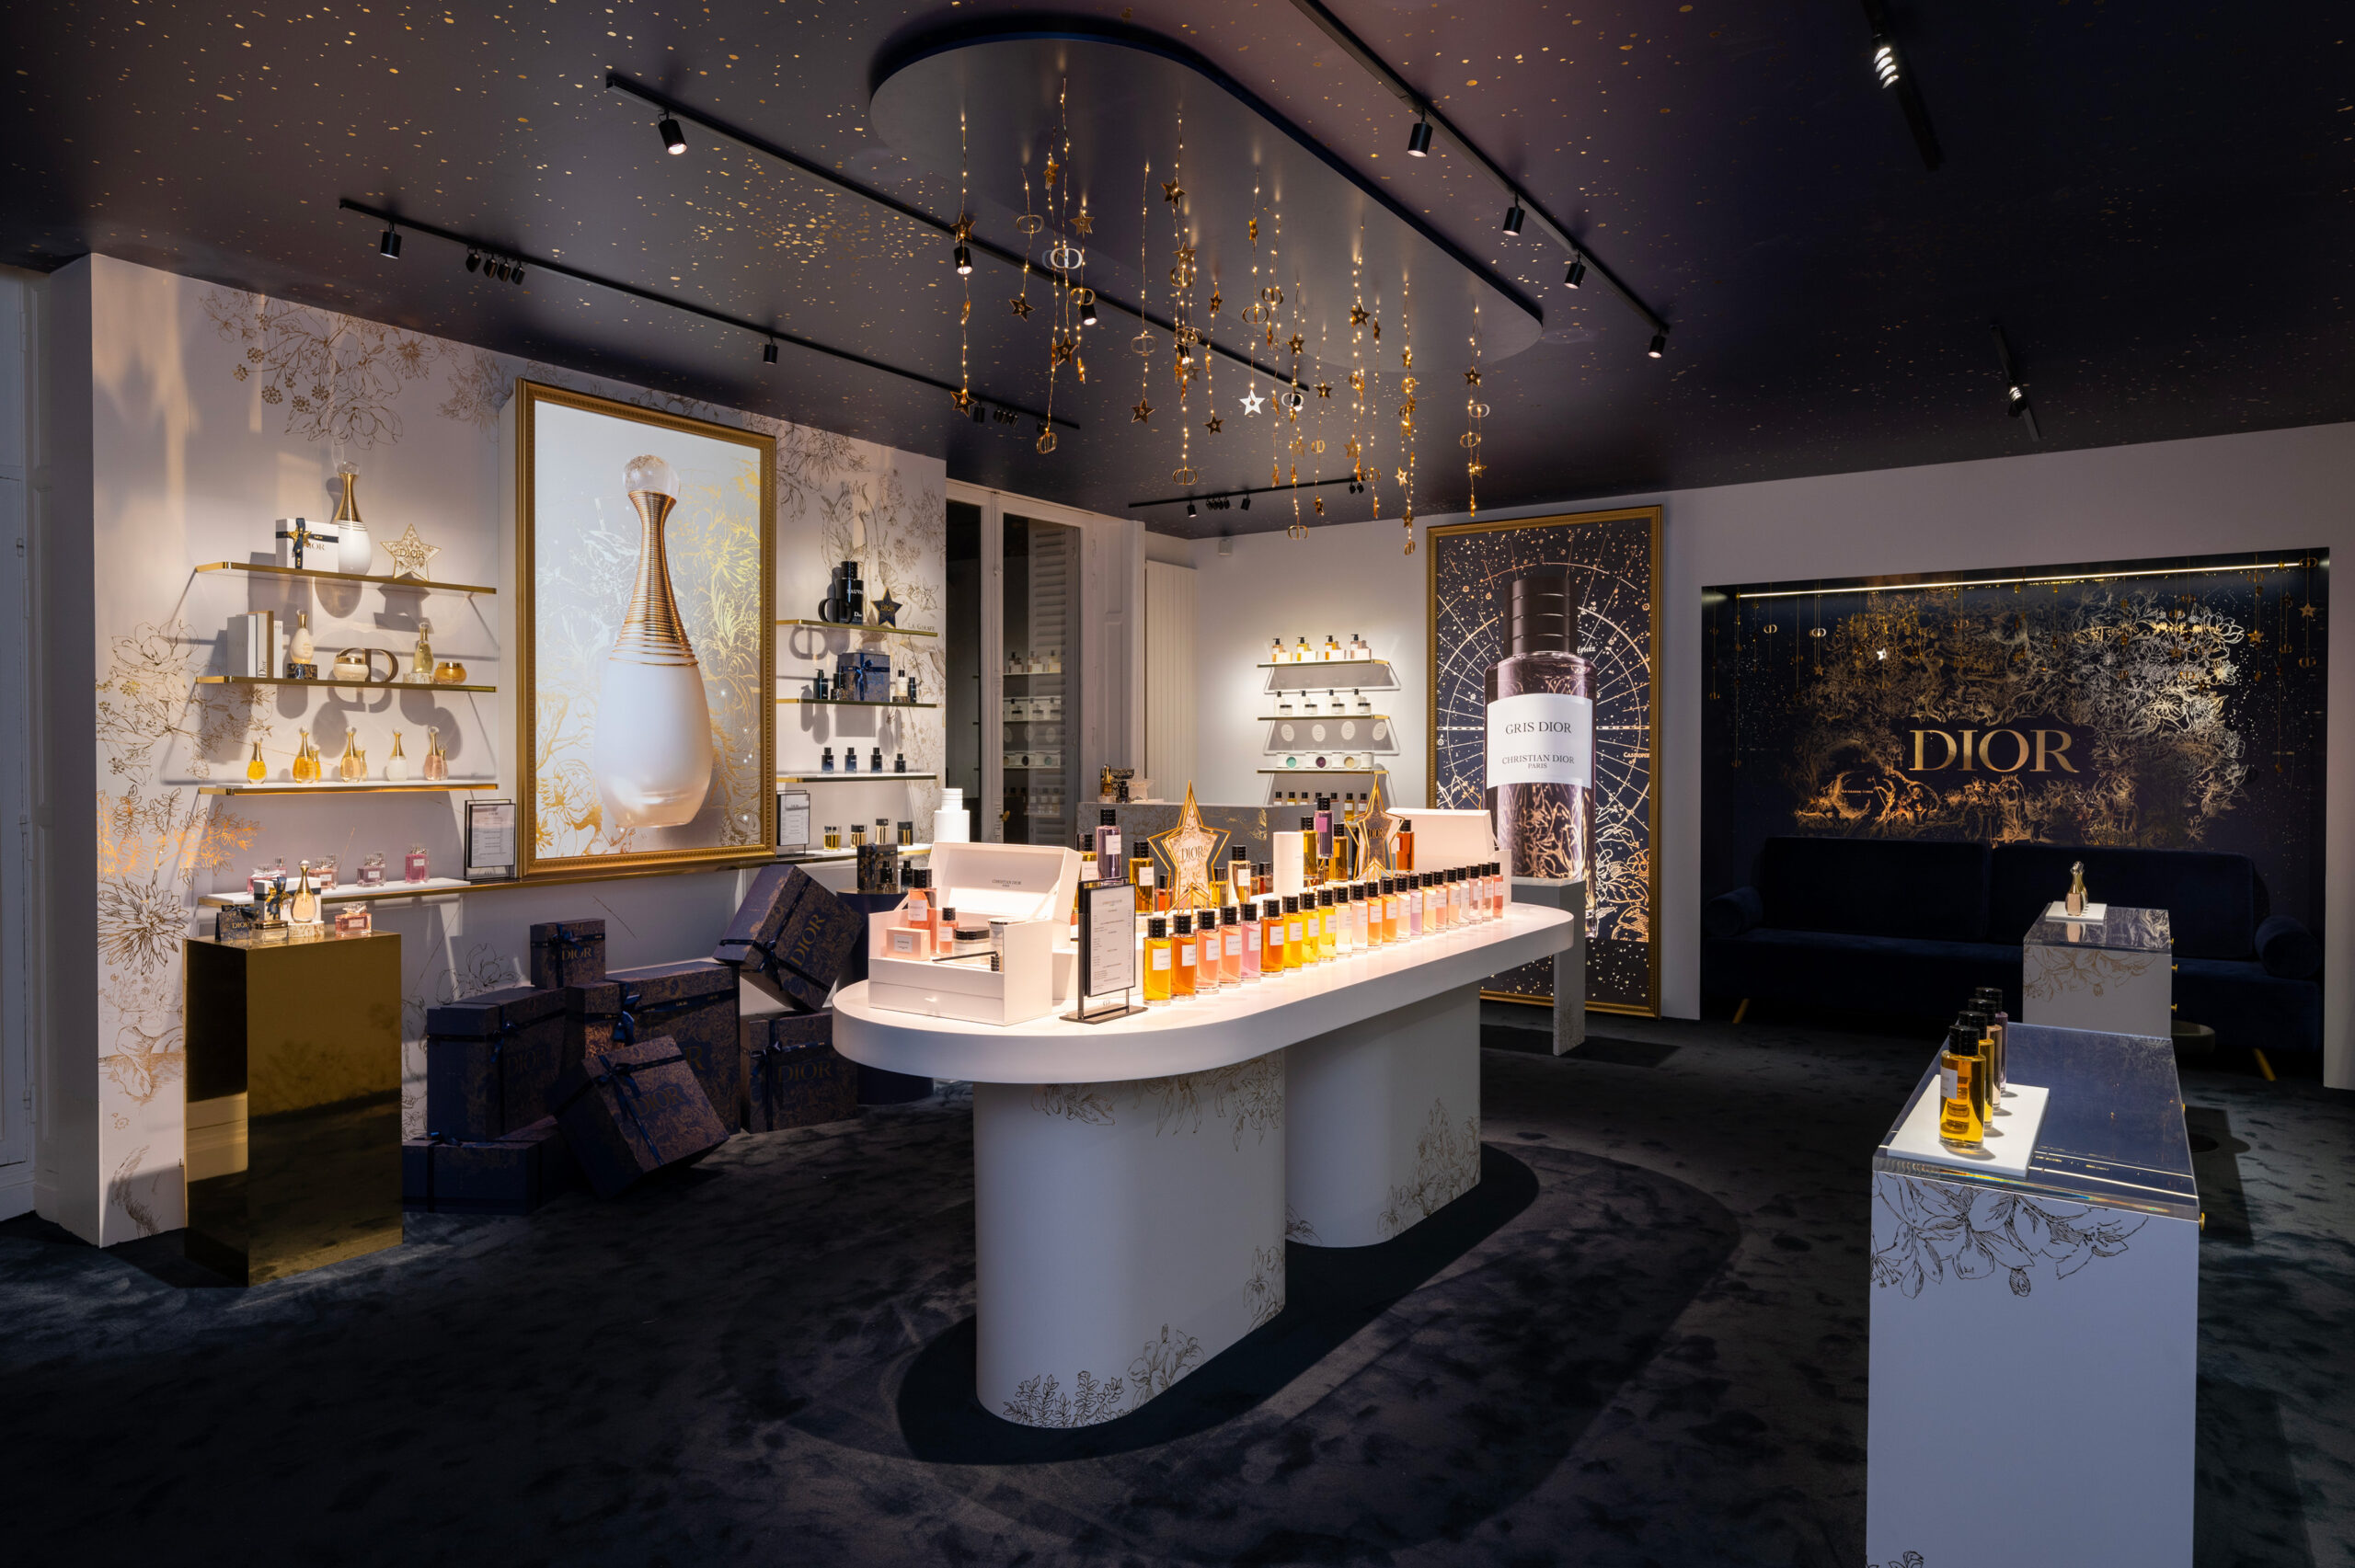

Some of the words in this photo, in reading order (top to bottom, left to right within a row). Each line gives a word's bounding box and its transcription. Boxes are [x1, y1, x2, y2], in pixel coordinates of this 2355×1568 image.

[397, 548, 426, 559] DIOR
[258, 661, 267, 677] Dior
[1505, 721, 1535, 735] GRIS
[1538, 721, 1572, 734] DIOR
[1908, 728, 2081, 773] DIOR
[1501, 754, 1550, 765] CHRISTIAN
[1552, 754, 1575, 764] DIOR
[1369, 827, 1384, 840] DIOR
[1181, 845, 1204, 863] DIOR
[232, 921, 250, 929] DIOR
[790, 914, 825, 967] DIOR
[561, 947, 593, 961] DIOR
[777, 1060, 833, 1083] DIOR
[632, 1086, 686, 1116] DIOR
